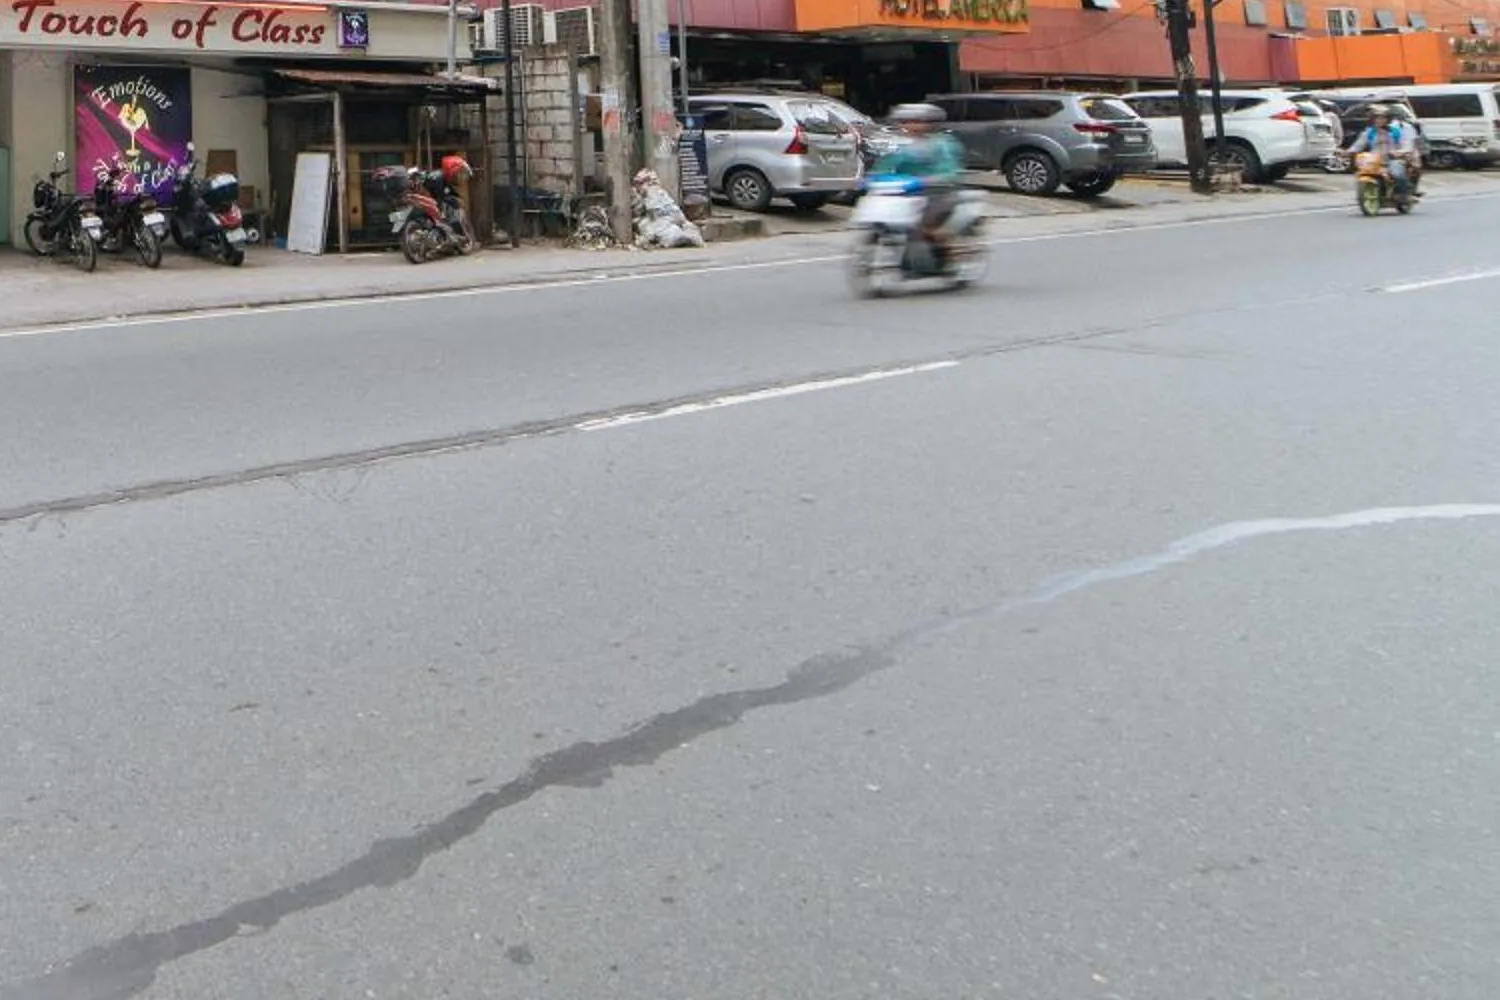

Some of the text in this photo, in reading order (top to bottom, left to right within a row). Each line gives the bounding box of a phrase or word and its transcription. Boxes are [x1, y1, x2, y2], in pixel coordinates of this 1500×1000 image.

[171, 4, 218, 48] of
[231, 8, 325, 45] Class
[90, 75, 173, 110] Emotions
